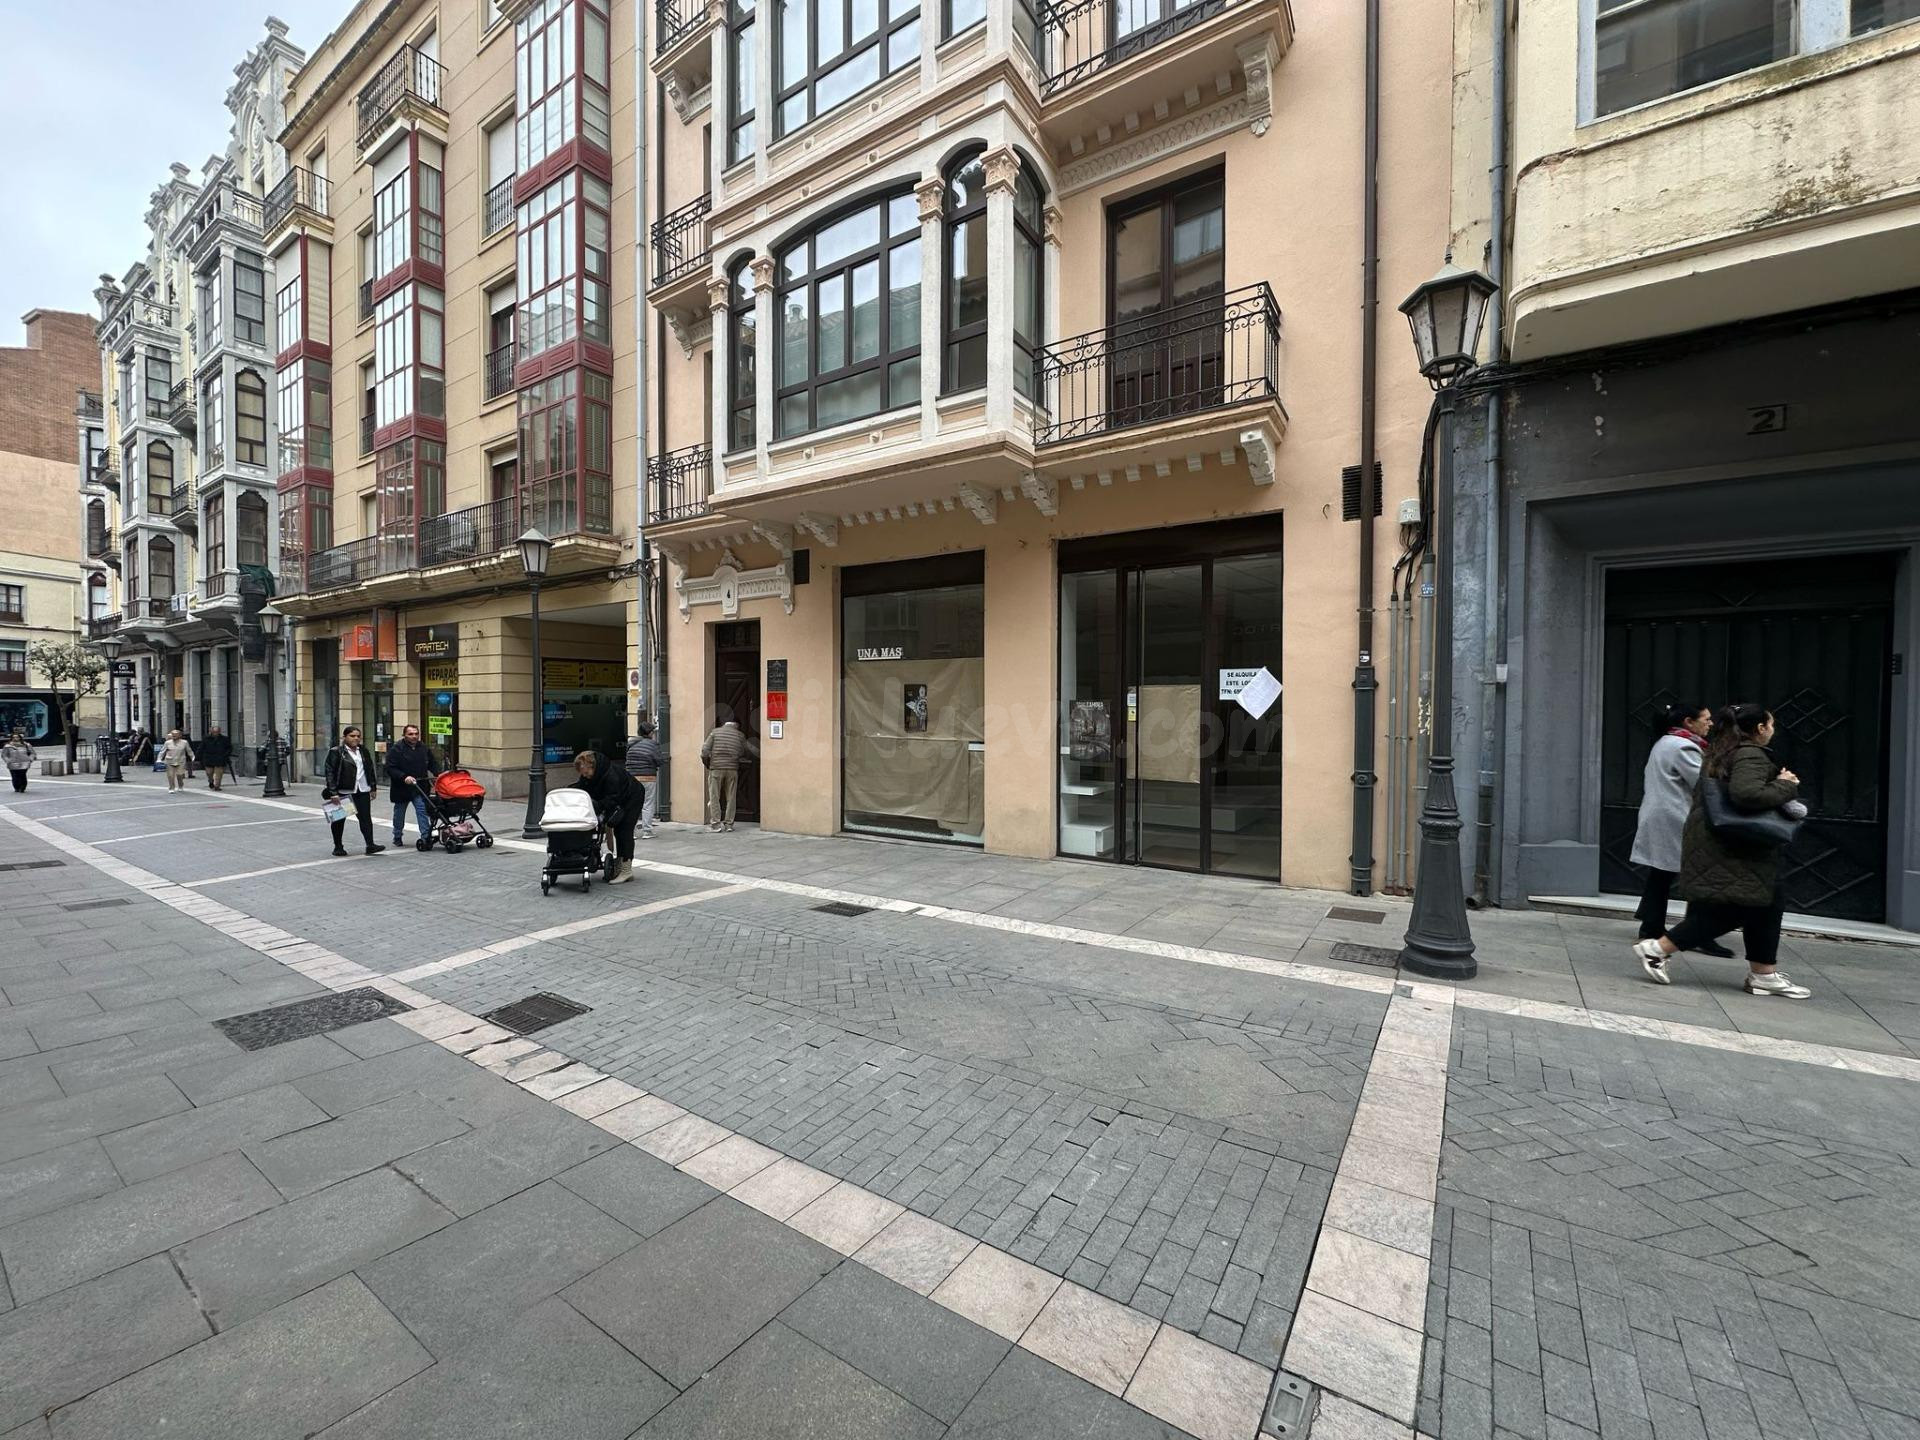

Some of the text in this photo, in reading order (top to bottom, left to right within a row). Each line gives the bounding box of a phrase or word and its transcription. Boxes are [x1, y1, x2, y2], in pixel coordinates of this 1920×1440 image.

[1753, 410, 1775, 430] 2
[857, 647, 902, 658] UNA MAS
